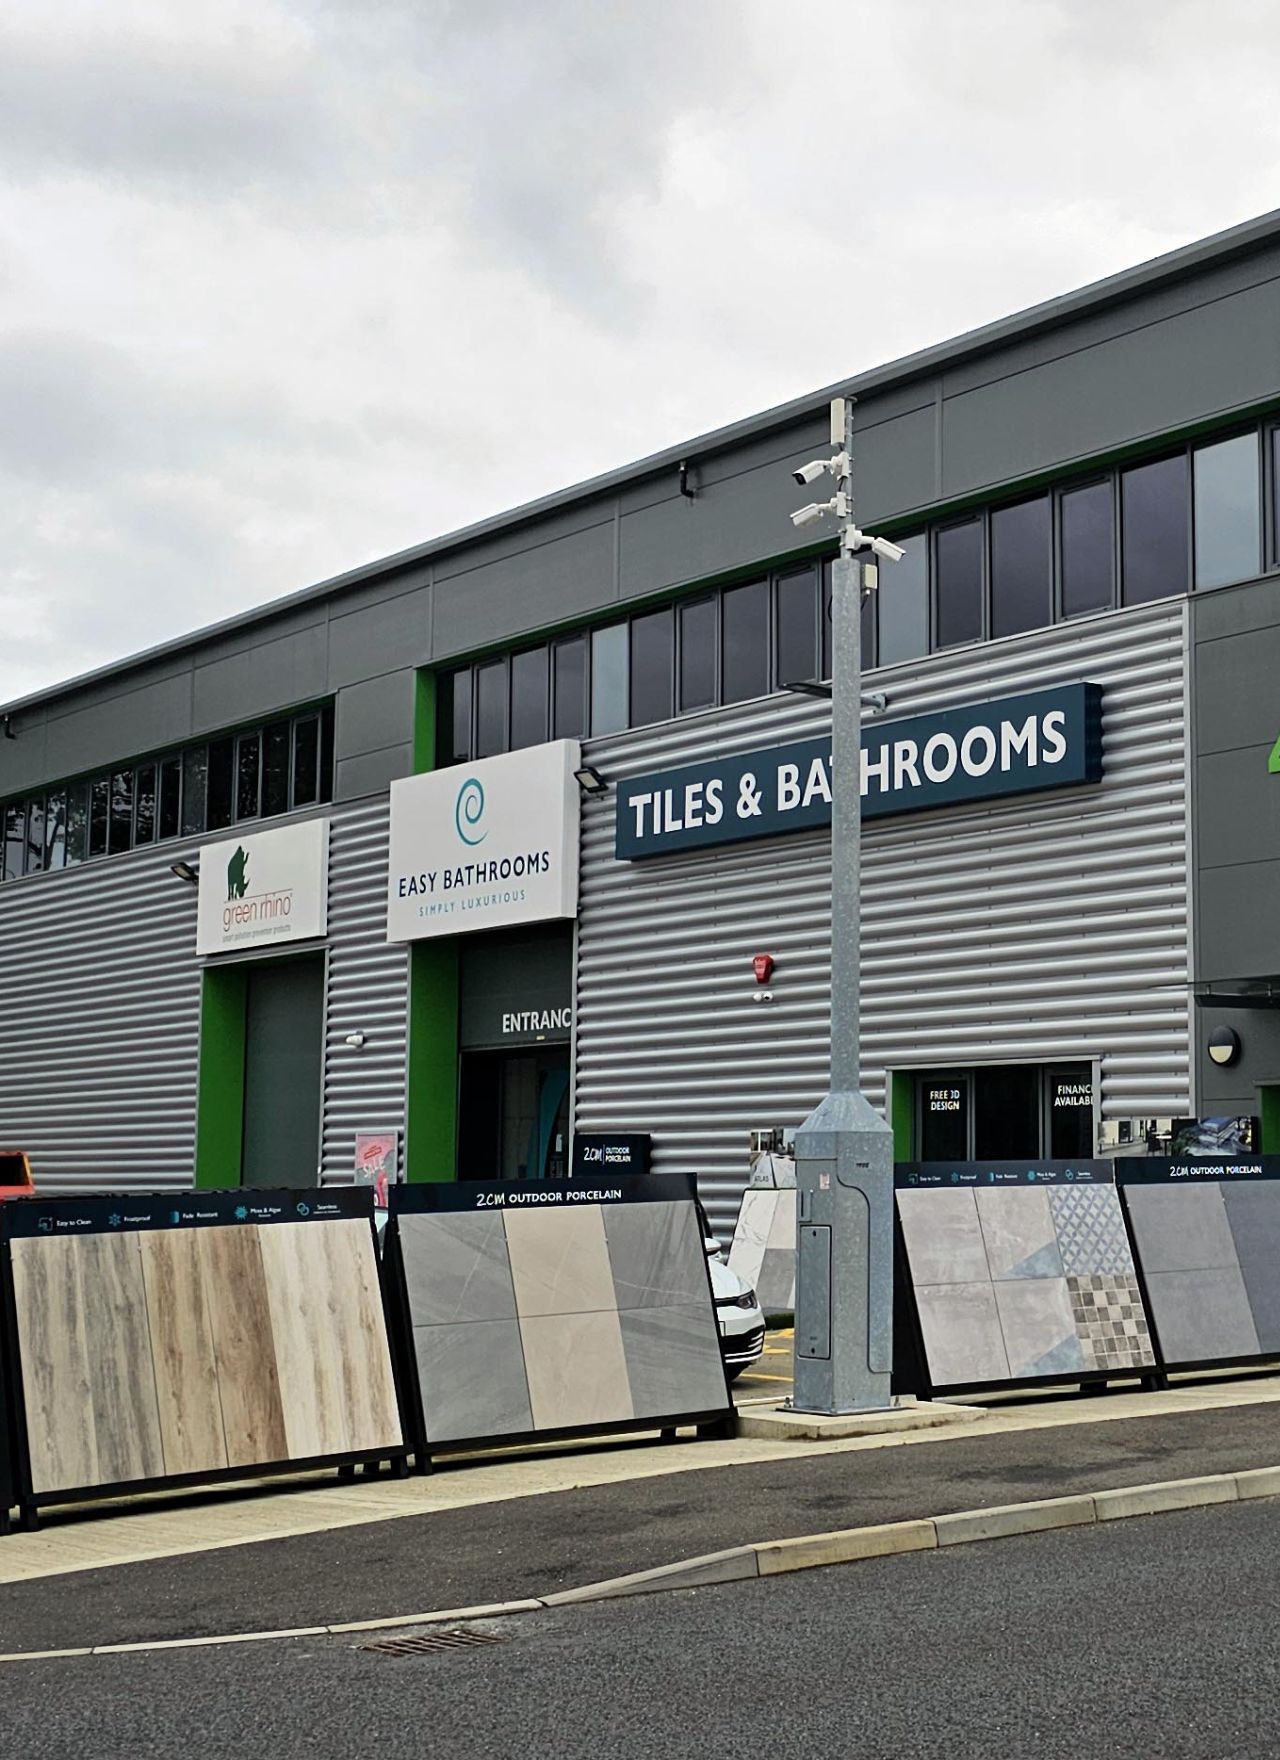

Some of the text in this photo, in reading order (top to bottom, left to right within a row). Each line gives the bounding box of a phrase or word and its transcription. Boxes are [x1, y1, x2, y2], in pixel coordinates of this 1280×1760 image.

[629, 710, 1067, 838] TILES & BAHROOMS
[398, 851, 550, 898] EASY BATHROOMS
[419, 889, 526, 917] SIMPLY LUXURIOUS
[223, 902, 258, 932] green
[502, 1007, 571, 1033] ENTRANC
[930, 1090, 948, 1100] FREE
[1057, 1084, 1093, 1096] FINANC
[930, 1101, 960, 1111] DESIGN
[605, 1146, 630, 1155] OUTDOOR
[605, 1155, 632, 1163] PORCELAIN
[1190, 1166, 1225, 1175] OUTDOOR
[1226, 1165, 1262, 1174] PORCELAIN
[508, 1192, 563, 1204] OUTDOOR
[566, 1189, 622, 1201] PORCELAIN
[56, 1219, 69, 1228] Easy
[76, 1218, 92, 1226] Clean
